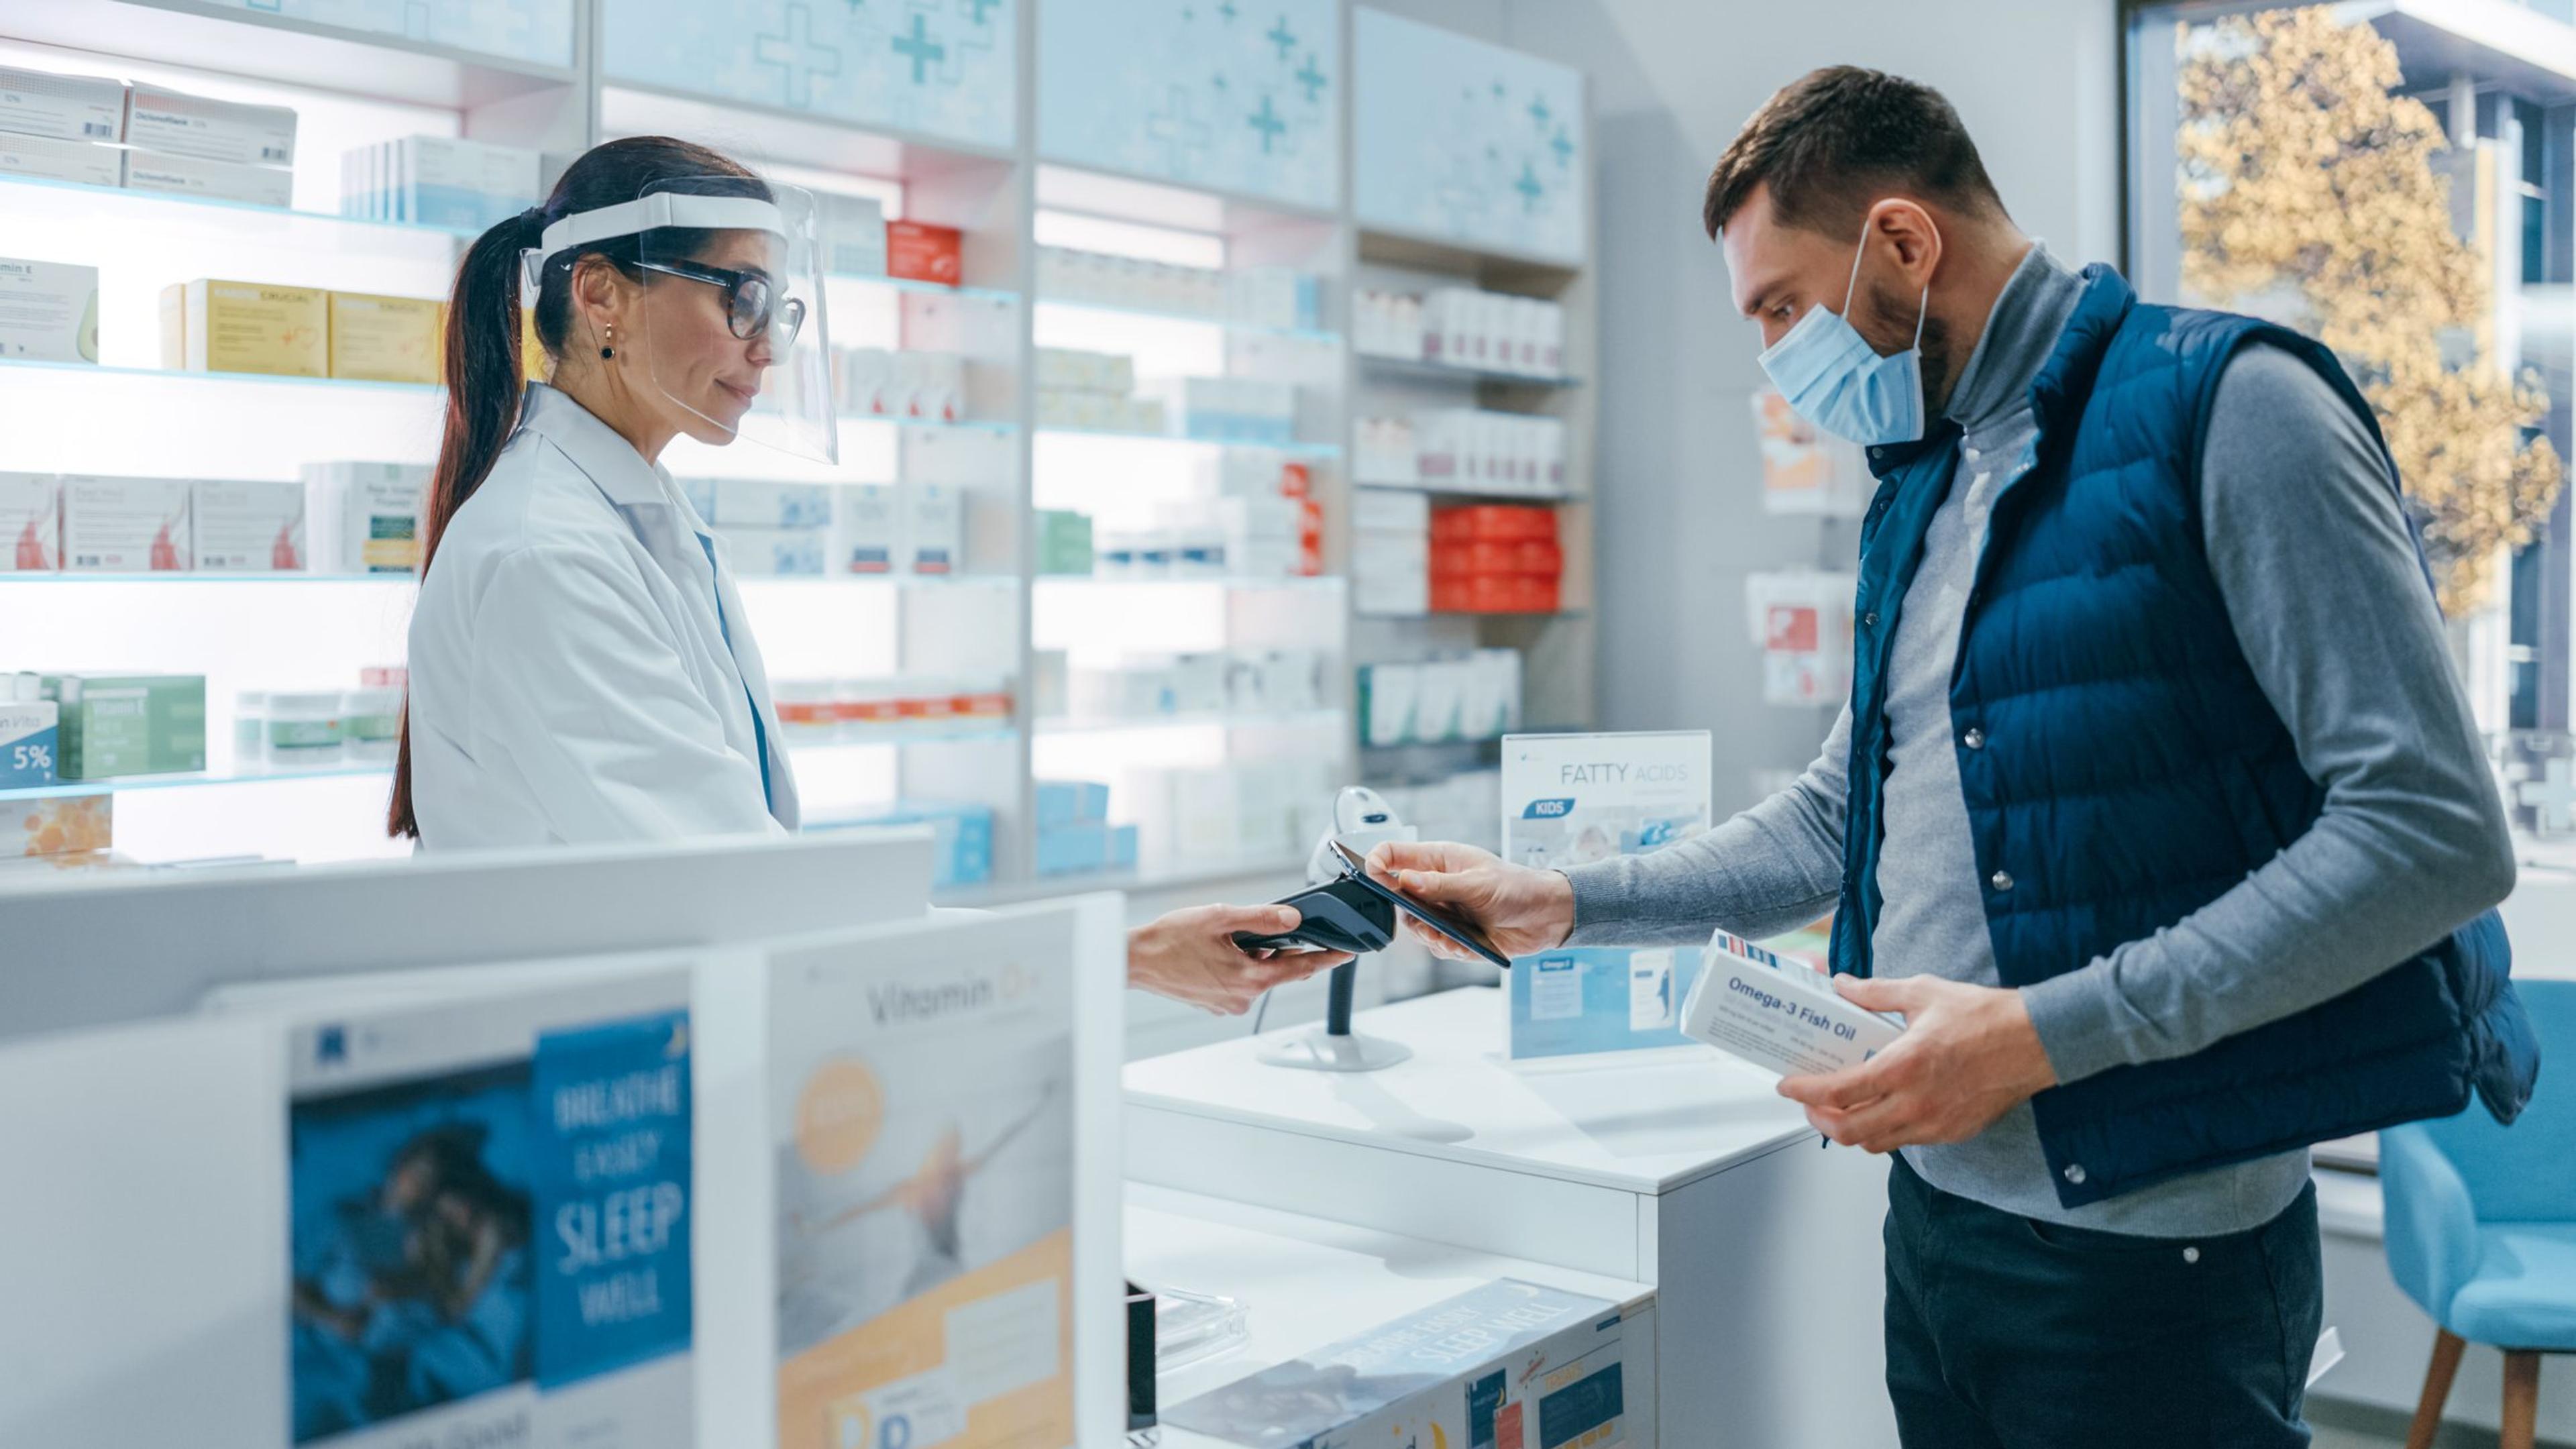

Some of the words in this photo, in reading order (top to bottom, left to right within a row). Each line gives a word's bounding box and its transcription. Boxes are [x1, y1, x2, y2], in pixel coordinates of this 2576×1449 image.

[13, 745, 52, 769] 5%
[1561, 763, 1629, 784] FATTY
[1634, 763, 1688, 782] ACIDS
[1535, 801, 1564, 815] KIDS
[867, 975, 994, 1025] Vitamin
[1728, 976, 1797, 1016] Omega-3
[1799, 1007, 1831, 1031] Fish
[1833, 1023, 1857, 1041] Oil
[553, 1064, 678, 1132] BREATHE
[555, 1181, 684, 1275] SLEEP
[578, 1269, 659, 1326] WELL
[1411, 1328, 1497, 1363] SLEEP
[1482, 1303, 1573, 1332] WELL
